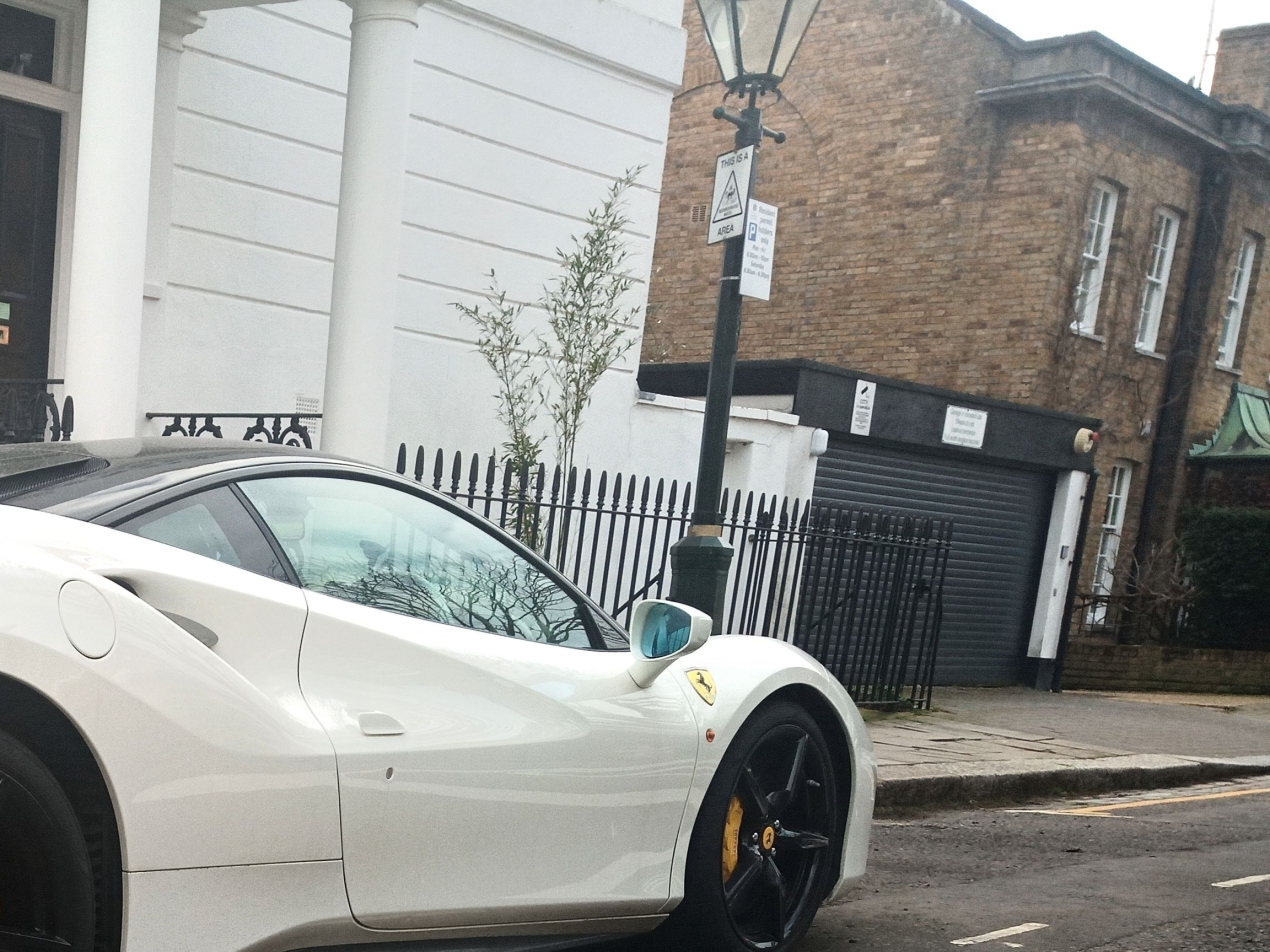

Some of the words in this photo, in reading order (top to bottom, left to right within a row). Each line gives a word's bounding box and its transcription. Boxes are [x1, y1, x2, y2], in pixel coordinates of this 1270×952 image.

[721, 157, 735, 168] THIS
[736, 154, 743, 163] IS
[744, 152, 749, 160] A
[717, 224, 734, 236] AREA
